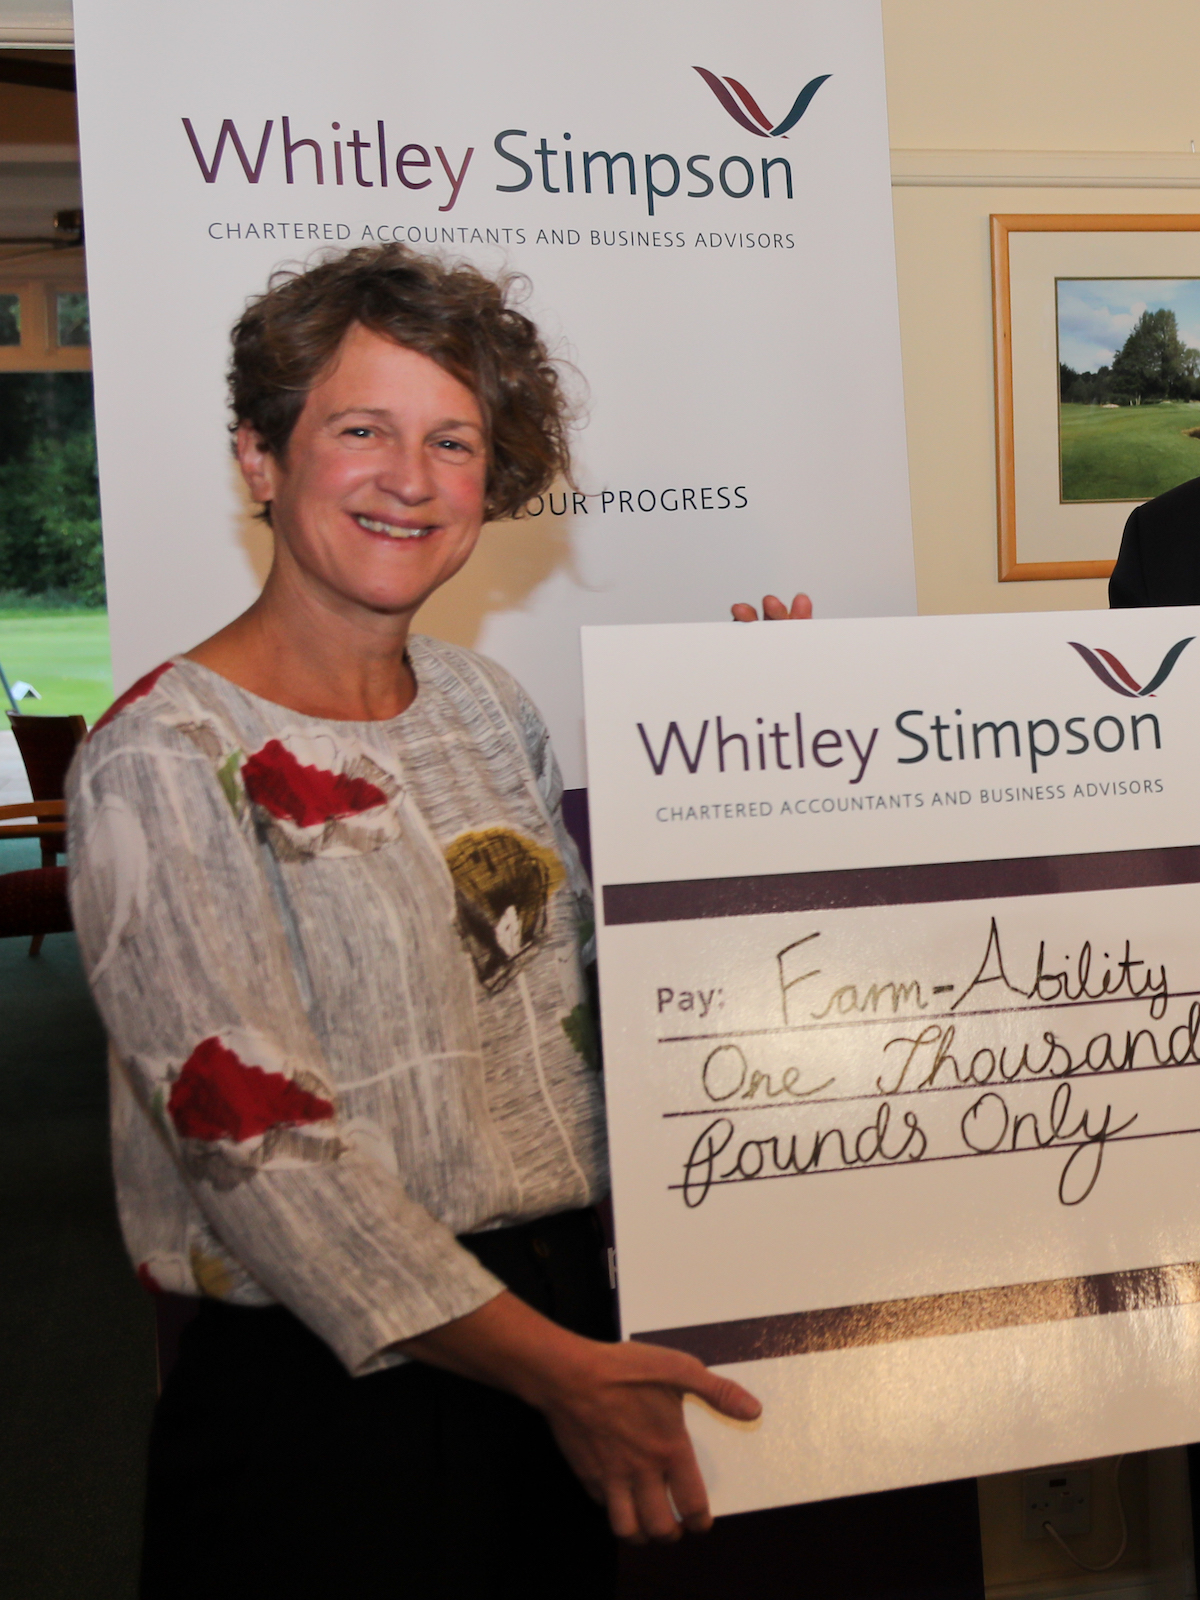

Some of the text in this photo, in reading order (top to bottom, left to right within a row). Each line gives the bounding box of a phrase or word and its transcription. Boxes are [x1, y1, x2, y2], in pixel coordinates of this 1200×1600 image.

[181, 116, 795, 217] Whitley Stimpson
[208, 221, 796, 250] CHARTERED ACCOUNTANTS AND BUSINESS ADVISORS
[601, 485, 749, 514] PROGRESS
[636, 708, 1162, 784] Whitley Stimpson
[655, 778, 1165, 823] CHARTERED ACCOUNTANTS AND BUSINESS ADVISORS
[656, 916, 1169, 1026] Pay: Farm-Ability
[702, 1043, 835, 1102] One
[683, 1082, 1139, 1209] Pounds Only
